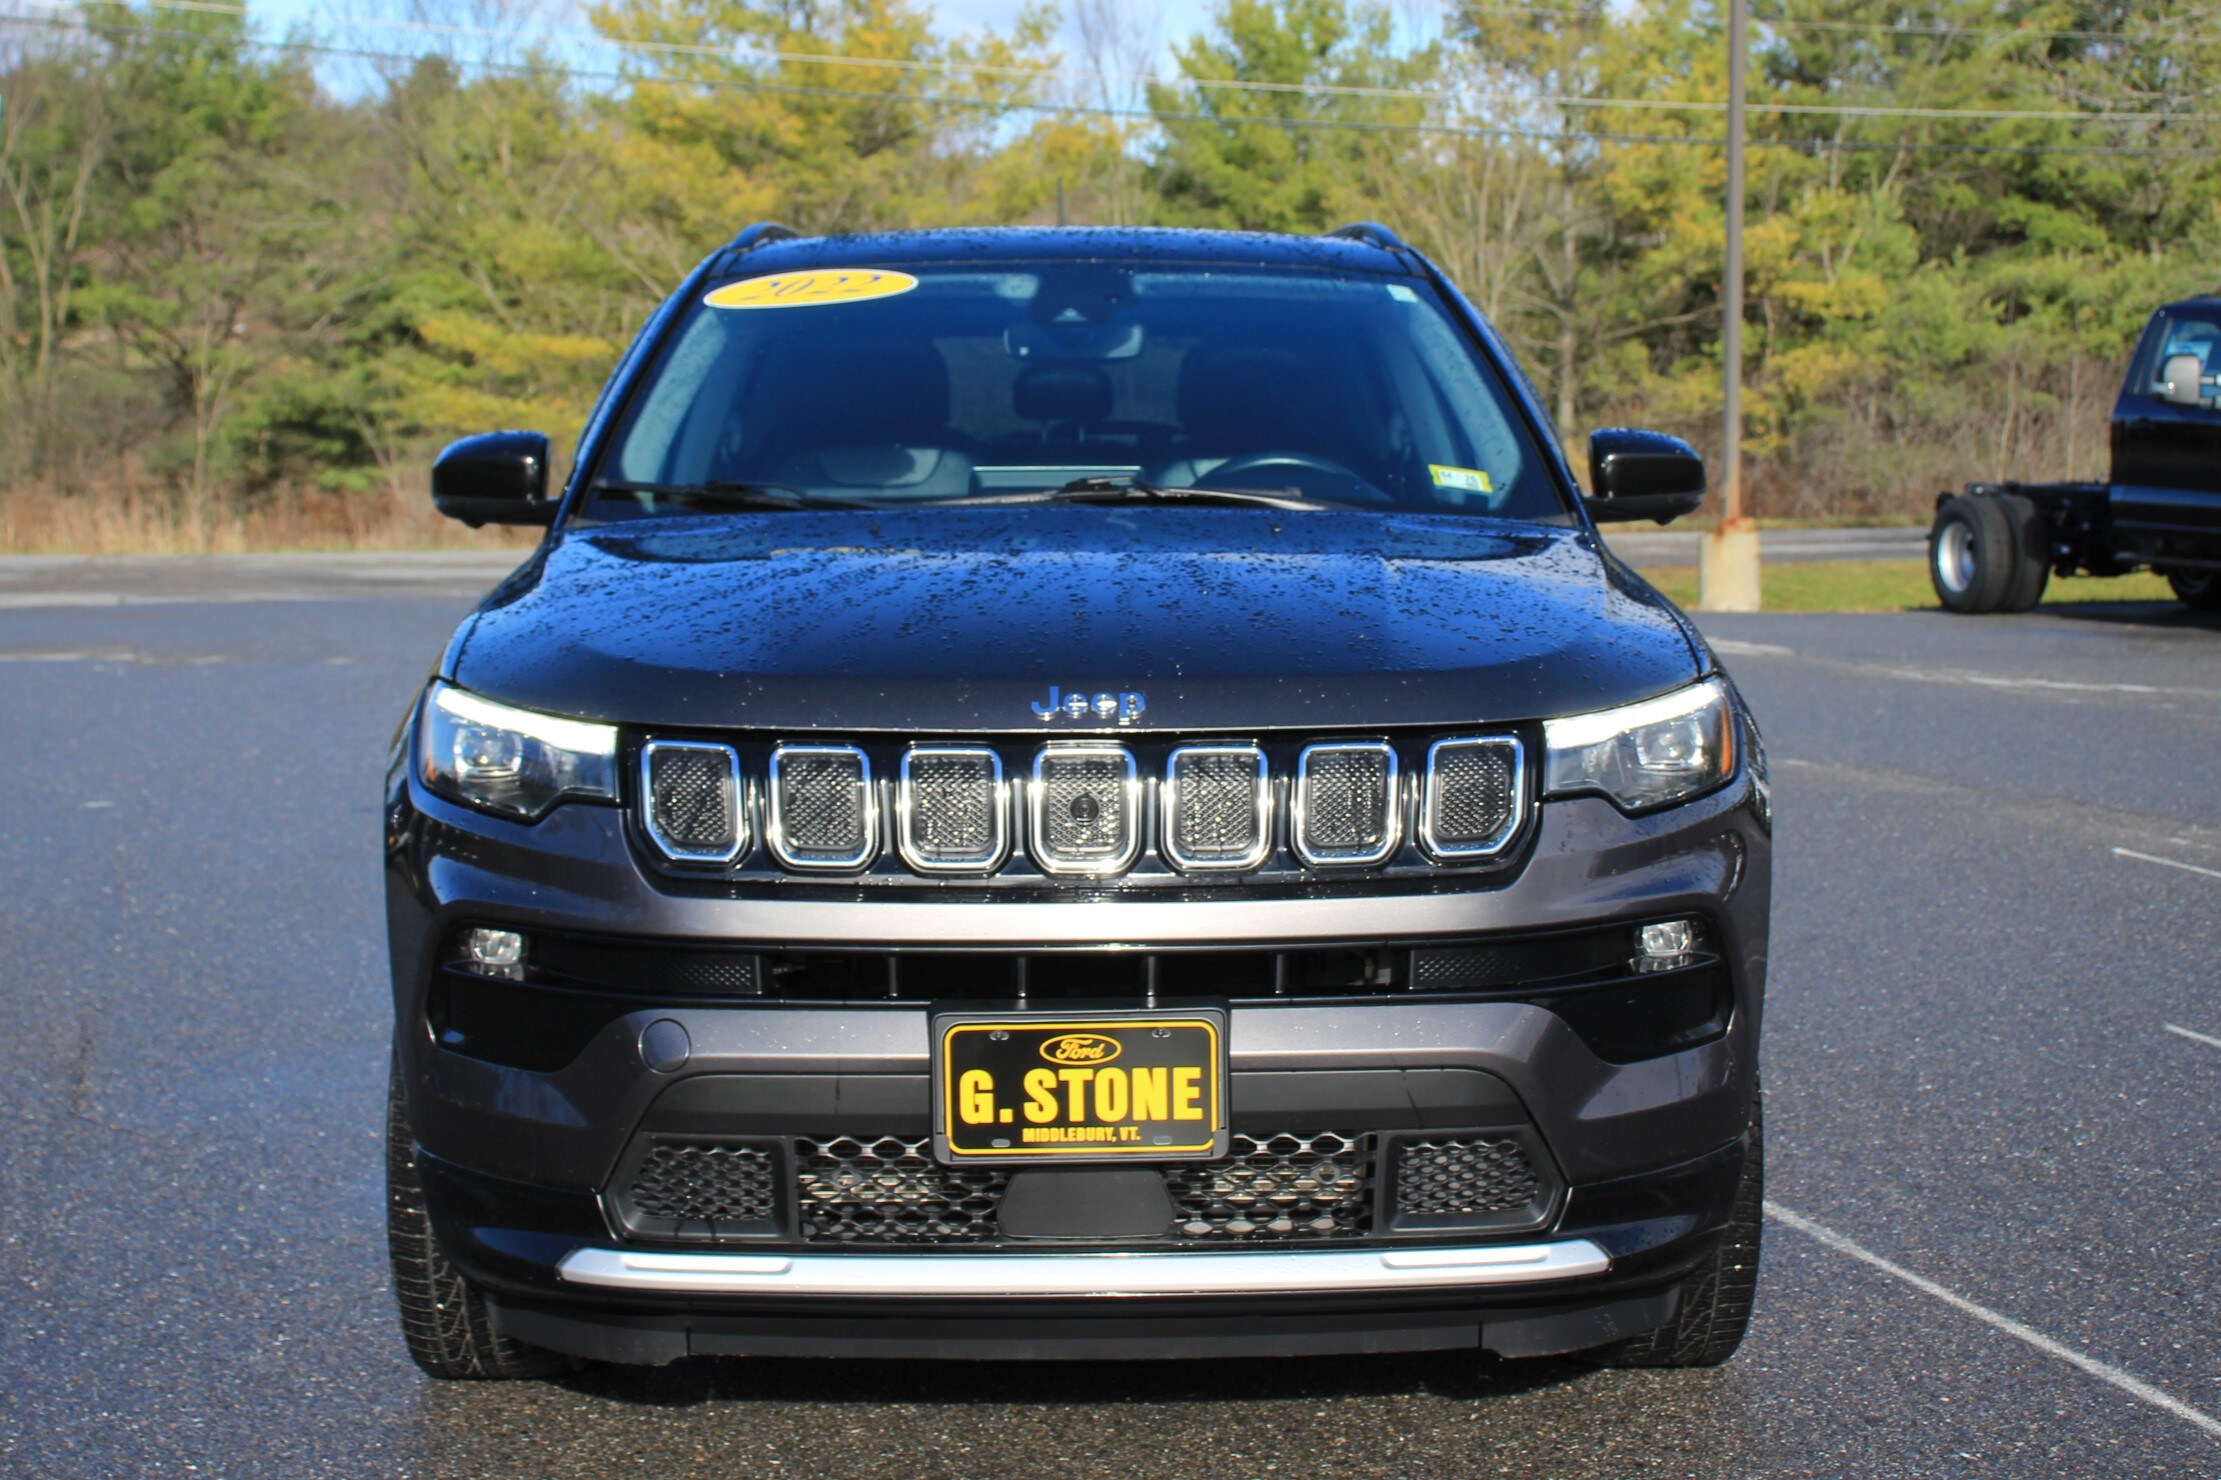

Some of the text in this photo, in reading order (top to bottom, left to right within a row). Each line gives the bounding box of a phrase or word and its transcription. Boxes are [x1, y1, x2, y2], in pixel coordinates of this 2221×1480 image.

[738, 274, 883, 301] 2022
[1030, 686, 1146, 723] Jeep
[1056, 1038, 1106, 1060] Ford
[959, 1066, 1203, 1125] G. STONE
[1022, 1125, 1142, 1143] MIDDLEBURY, VT.
